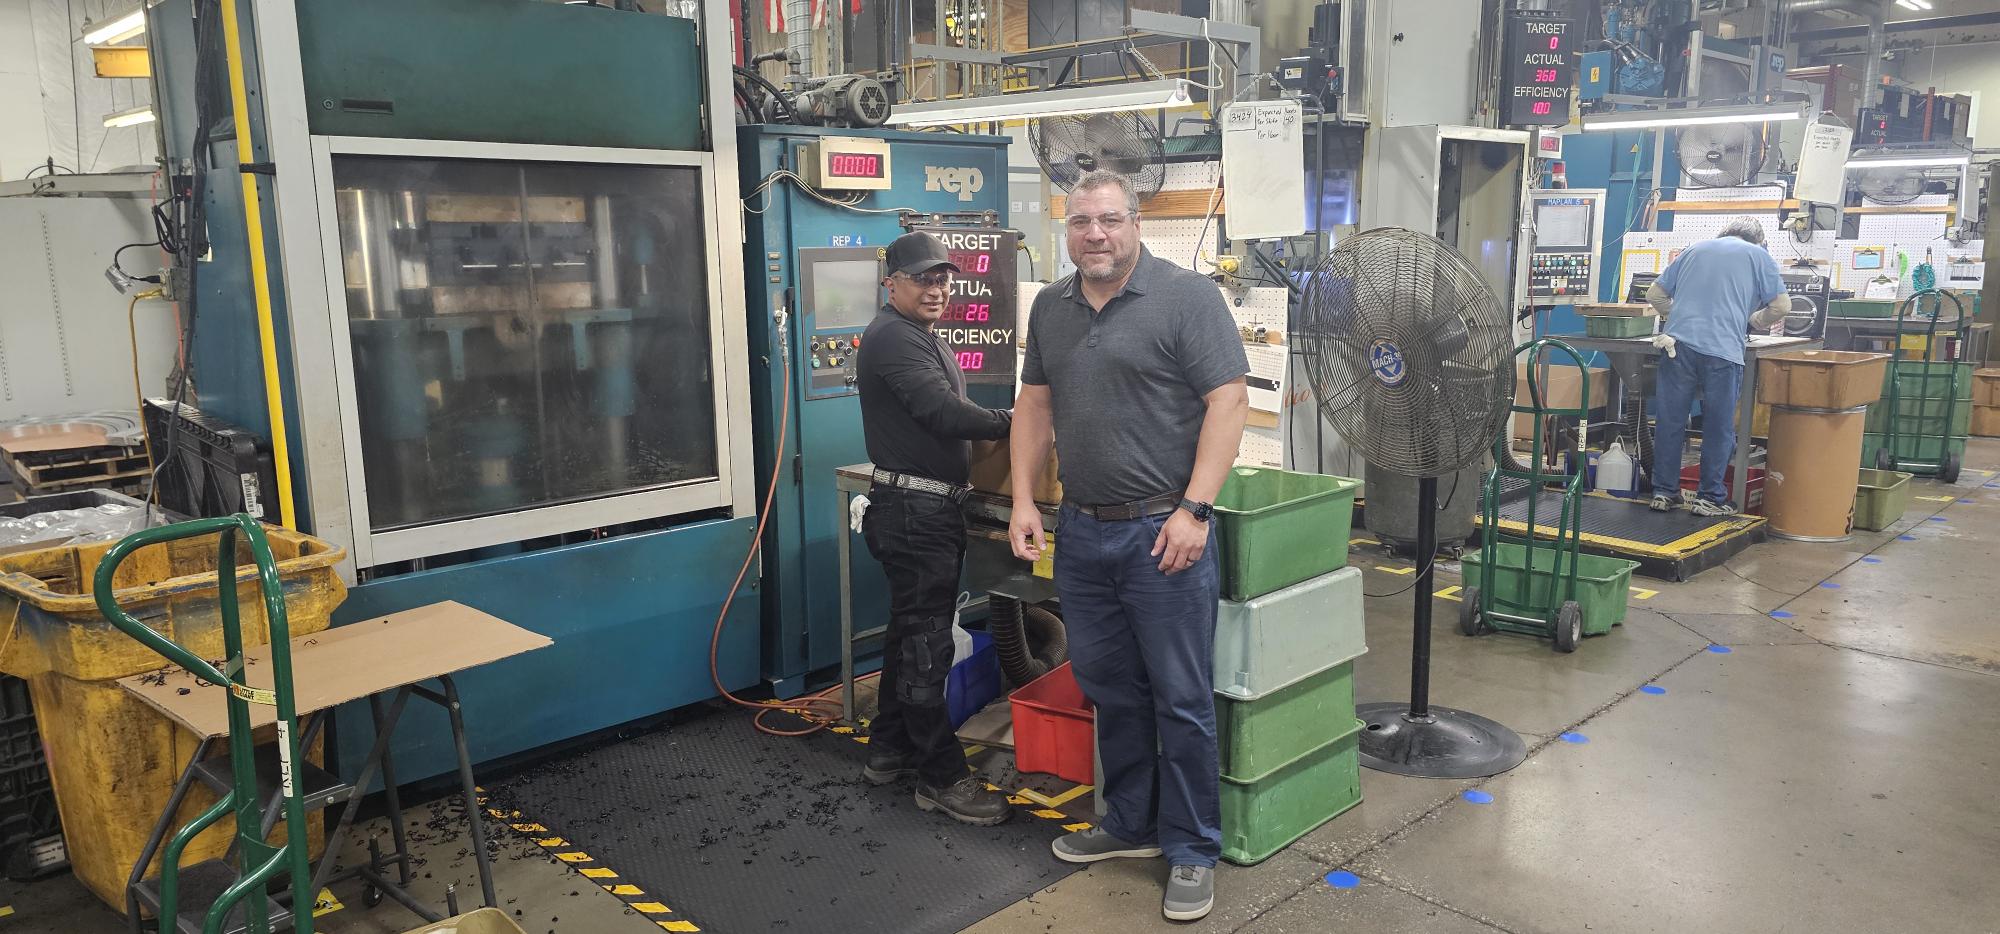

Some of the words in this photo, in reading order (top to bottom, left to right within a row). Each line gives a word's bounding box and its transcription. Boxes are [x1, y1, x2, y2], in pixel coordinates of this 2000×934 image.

[1526, 23, 1567, 34] TARGET
[1549, 36, 1559, 49] 0
[1524, 53, 1564, 65] ACTUAL
[1514, 86, 1569, 98] EFFICIENCY
[1532, 102, 1551, 114] 100
[925, 165, 984, 202] rep
[832, 235, 851, 247] REP
[855, 235, 862, 247] 4
[977, 254, 990, 273] 0
[966, 304, 989, 321] 26
